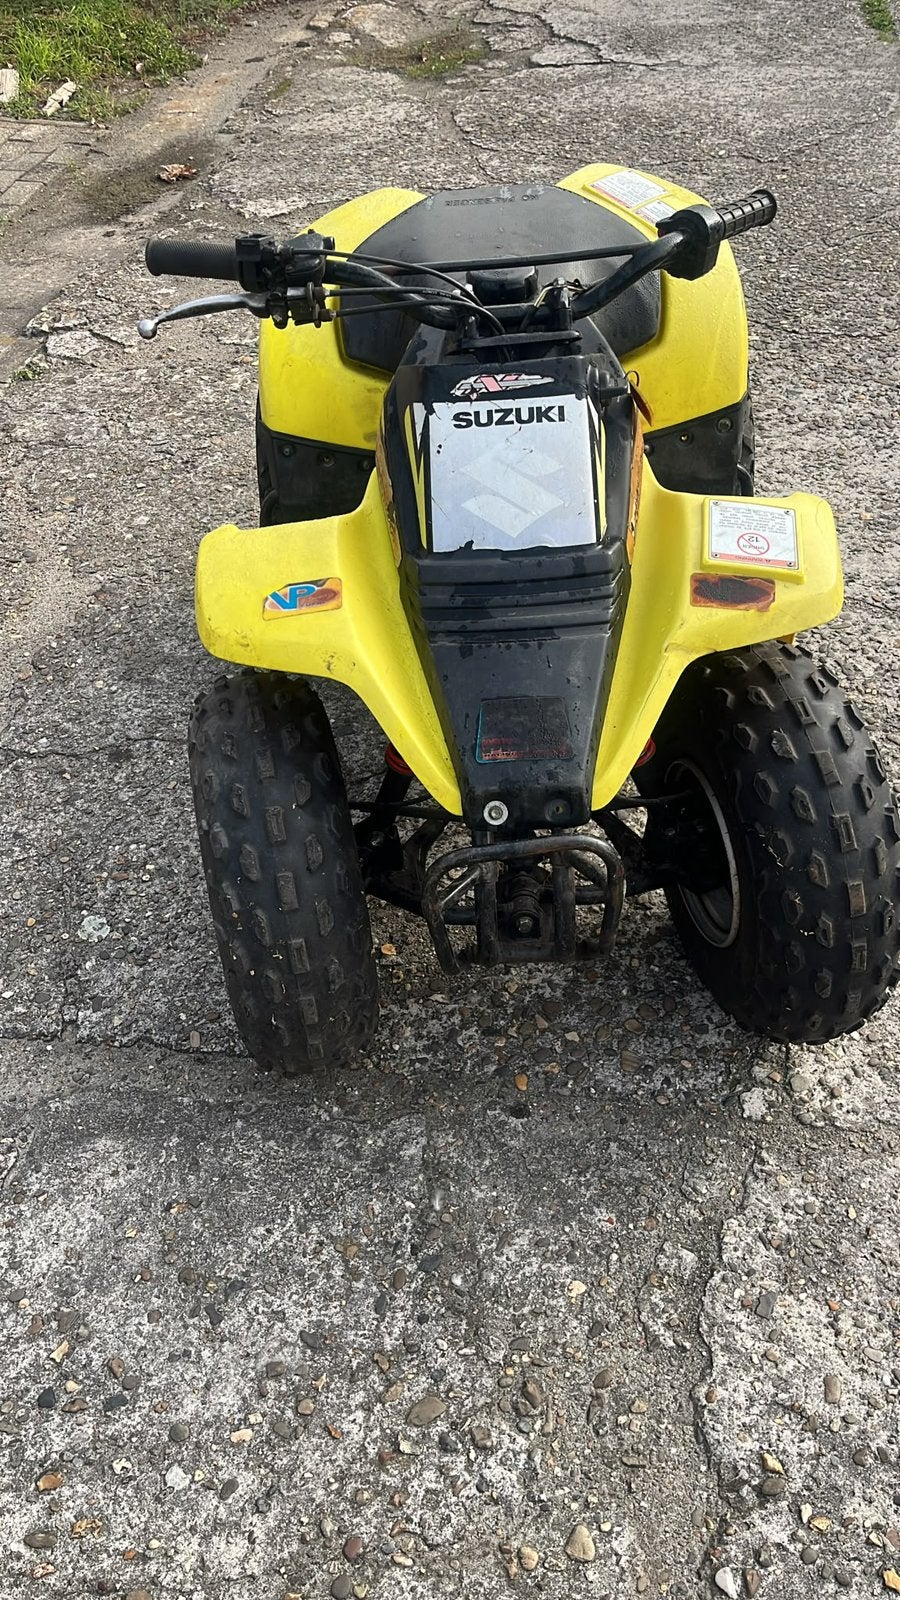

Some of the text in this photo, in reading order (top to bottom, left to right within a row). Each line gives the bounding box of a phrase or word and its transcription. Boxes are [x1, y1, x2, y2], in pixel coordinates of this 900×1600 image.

[452, 405, 566, 429] SUZUKI
[747, 535, 761, 543] 12
[268, 584, 317, 611] VP
